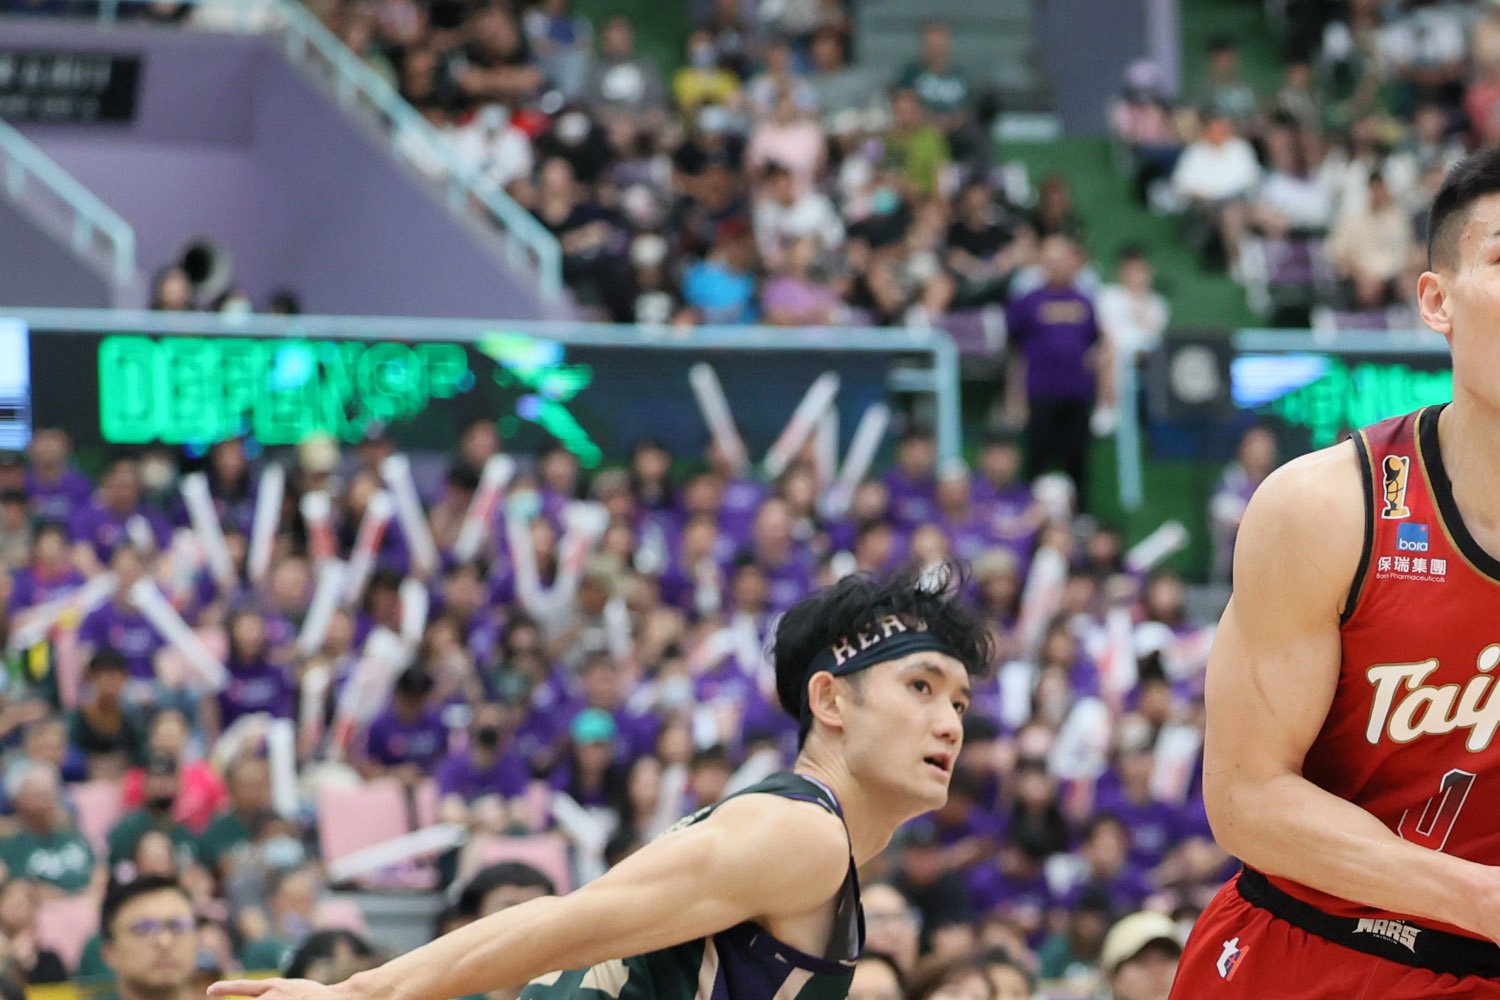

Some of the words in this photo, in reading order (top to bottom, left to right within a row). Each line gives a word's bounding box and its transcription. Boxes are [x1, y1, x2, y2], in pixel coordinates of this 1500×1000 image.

[1399, 538, 1429, 551] bora
[1378, 556, 1447, 576] 保瑞集團
[1352, 918, 1422, 953] MARS
